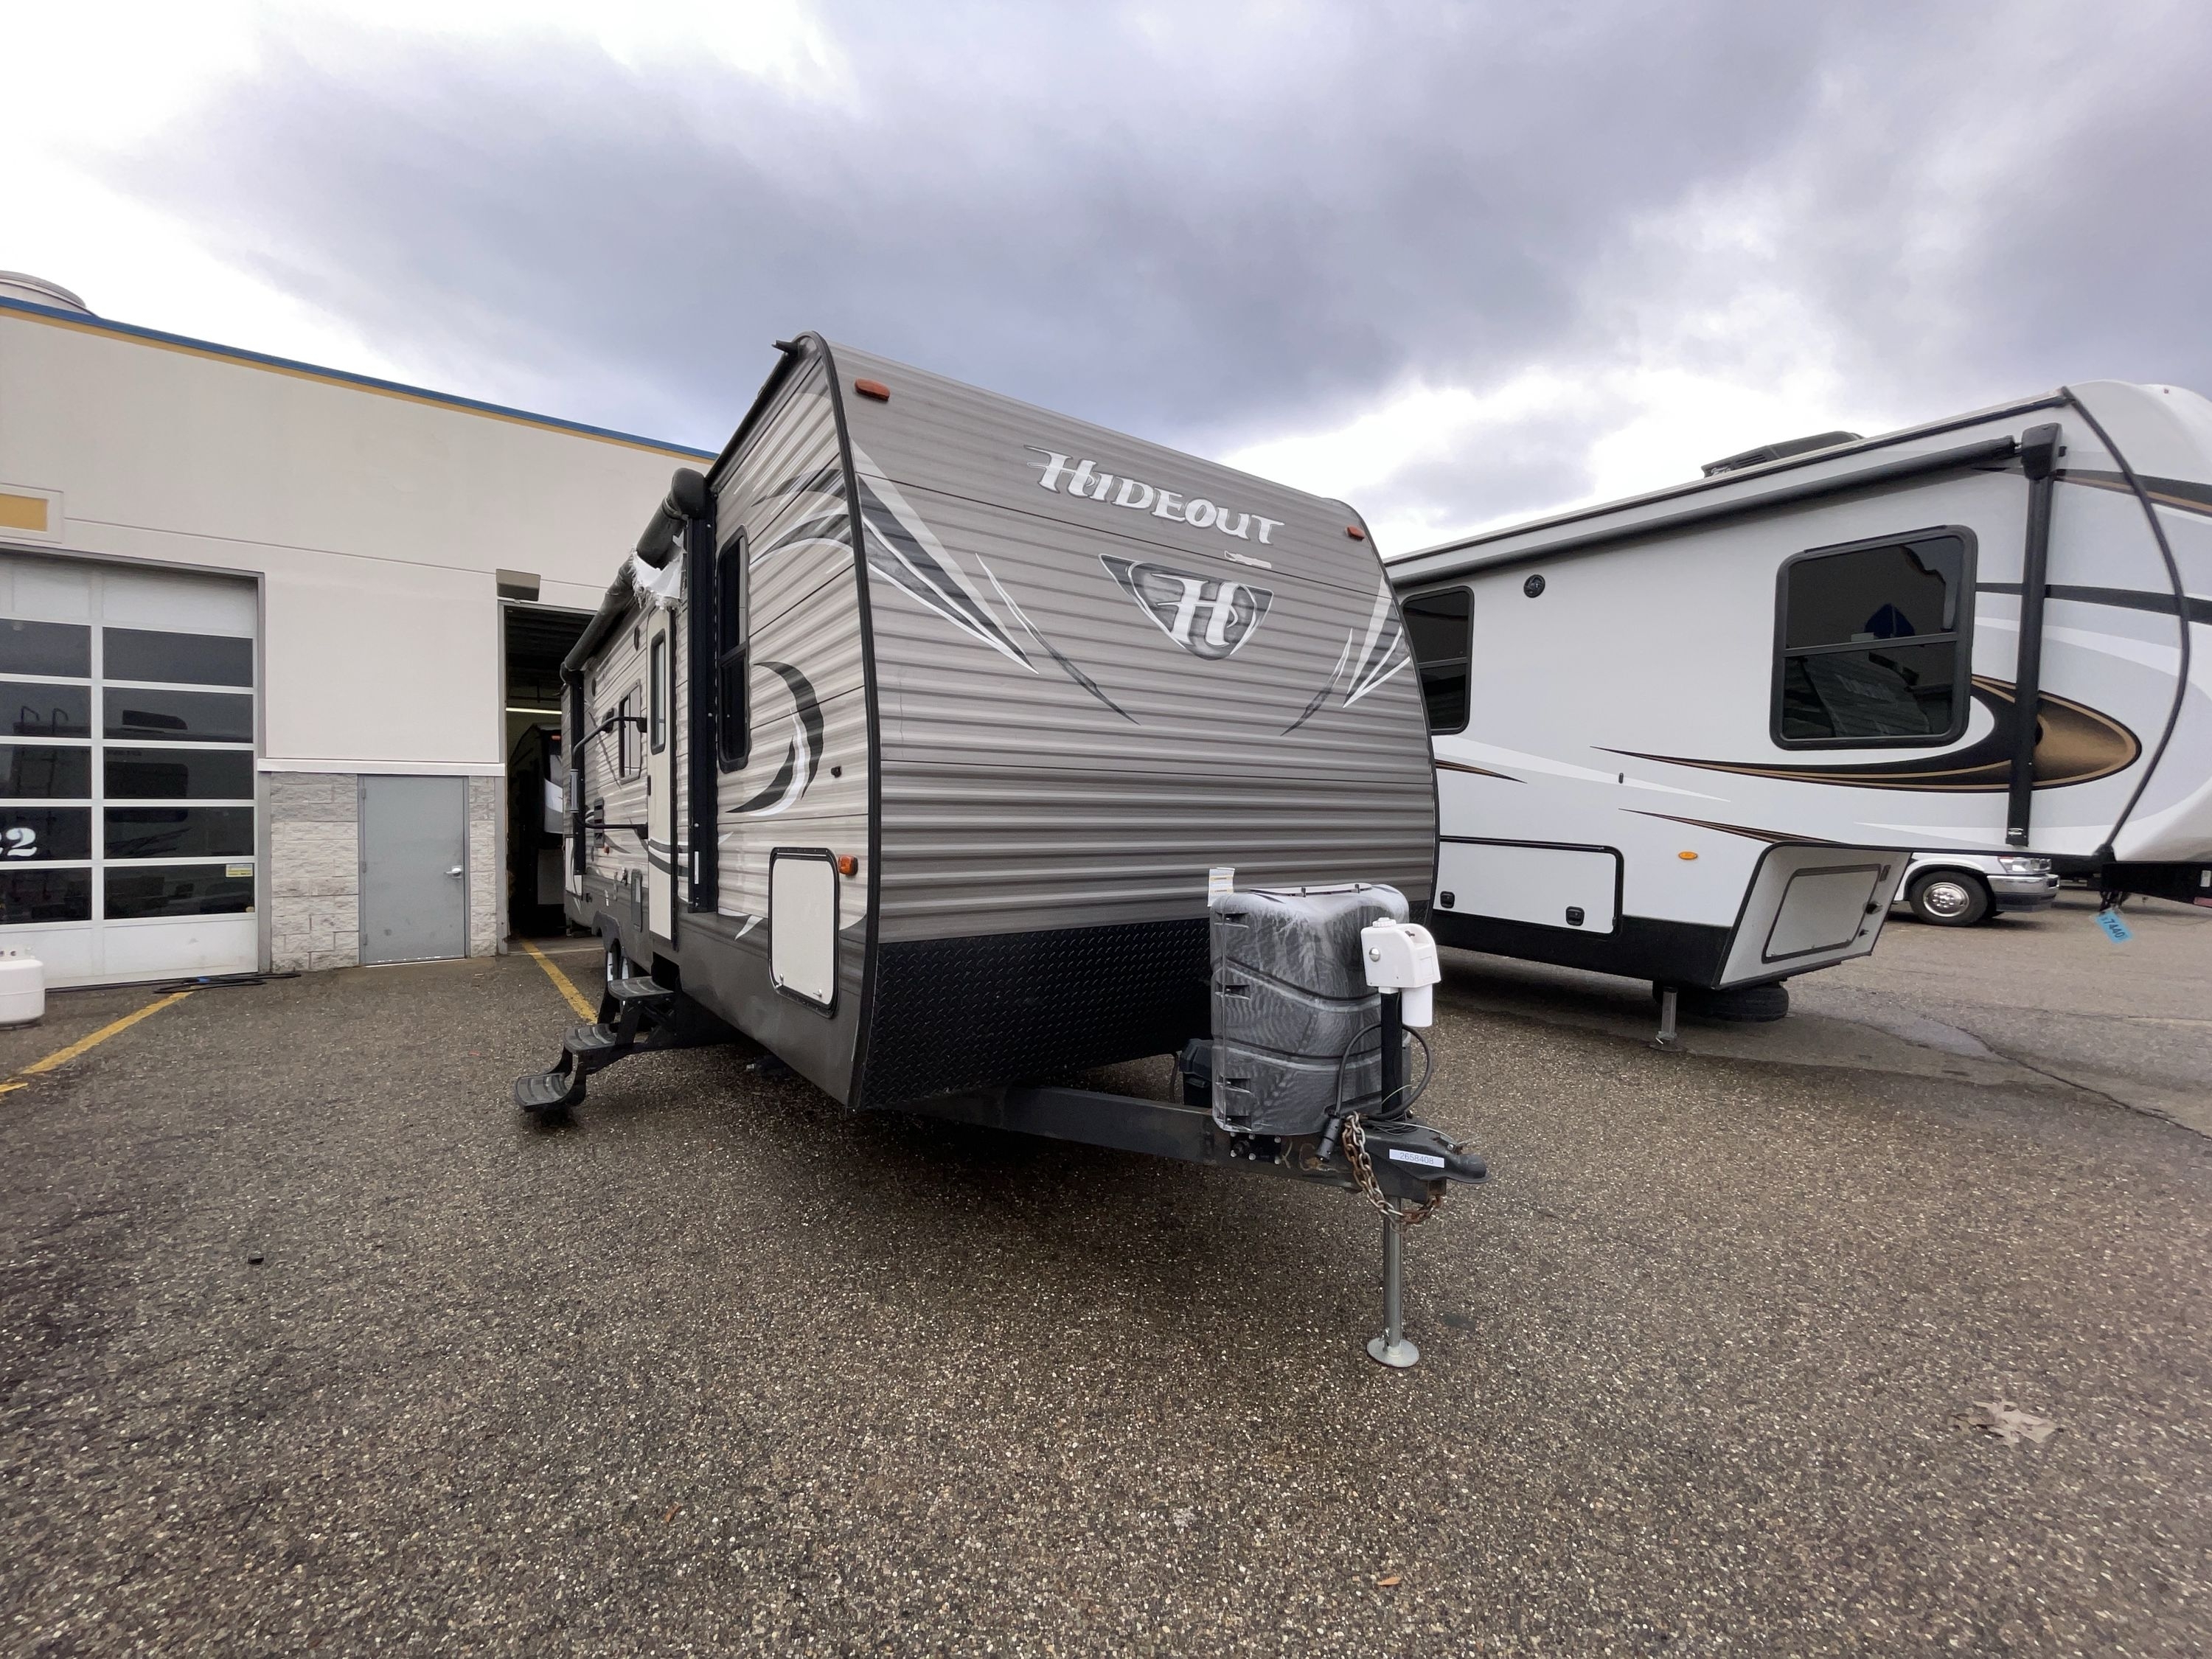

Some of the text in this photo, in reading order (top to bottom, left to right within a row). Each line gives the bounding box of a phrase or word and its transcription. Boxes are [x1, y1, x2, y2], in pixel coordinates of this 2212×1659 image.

[1024, 445, 1284, 544] HIDEOUT
[1152, 573, 1238, 646] H
[0, 827, 38, 857] 2
[1399, 1152, 1434, 1164] 2658408
